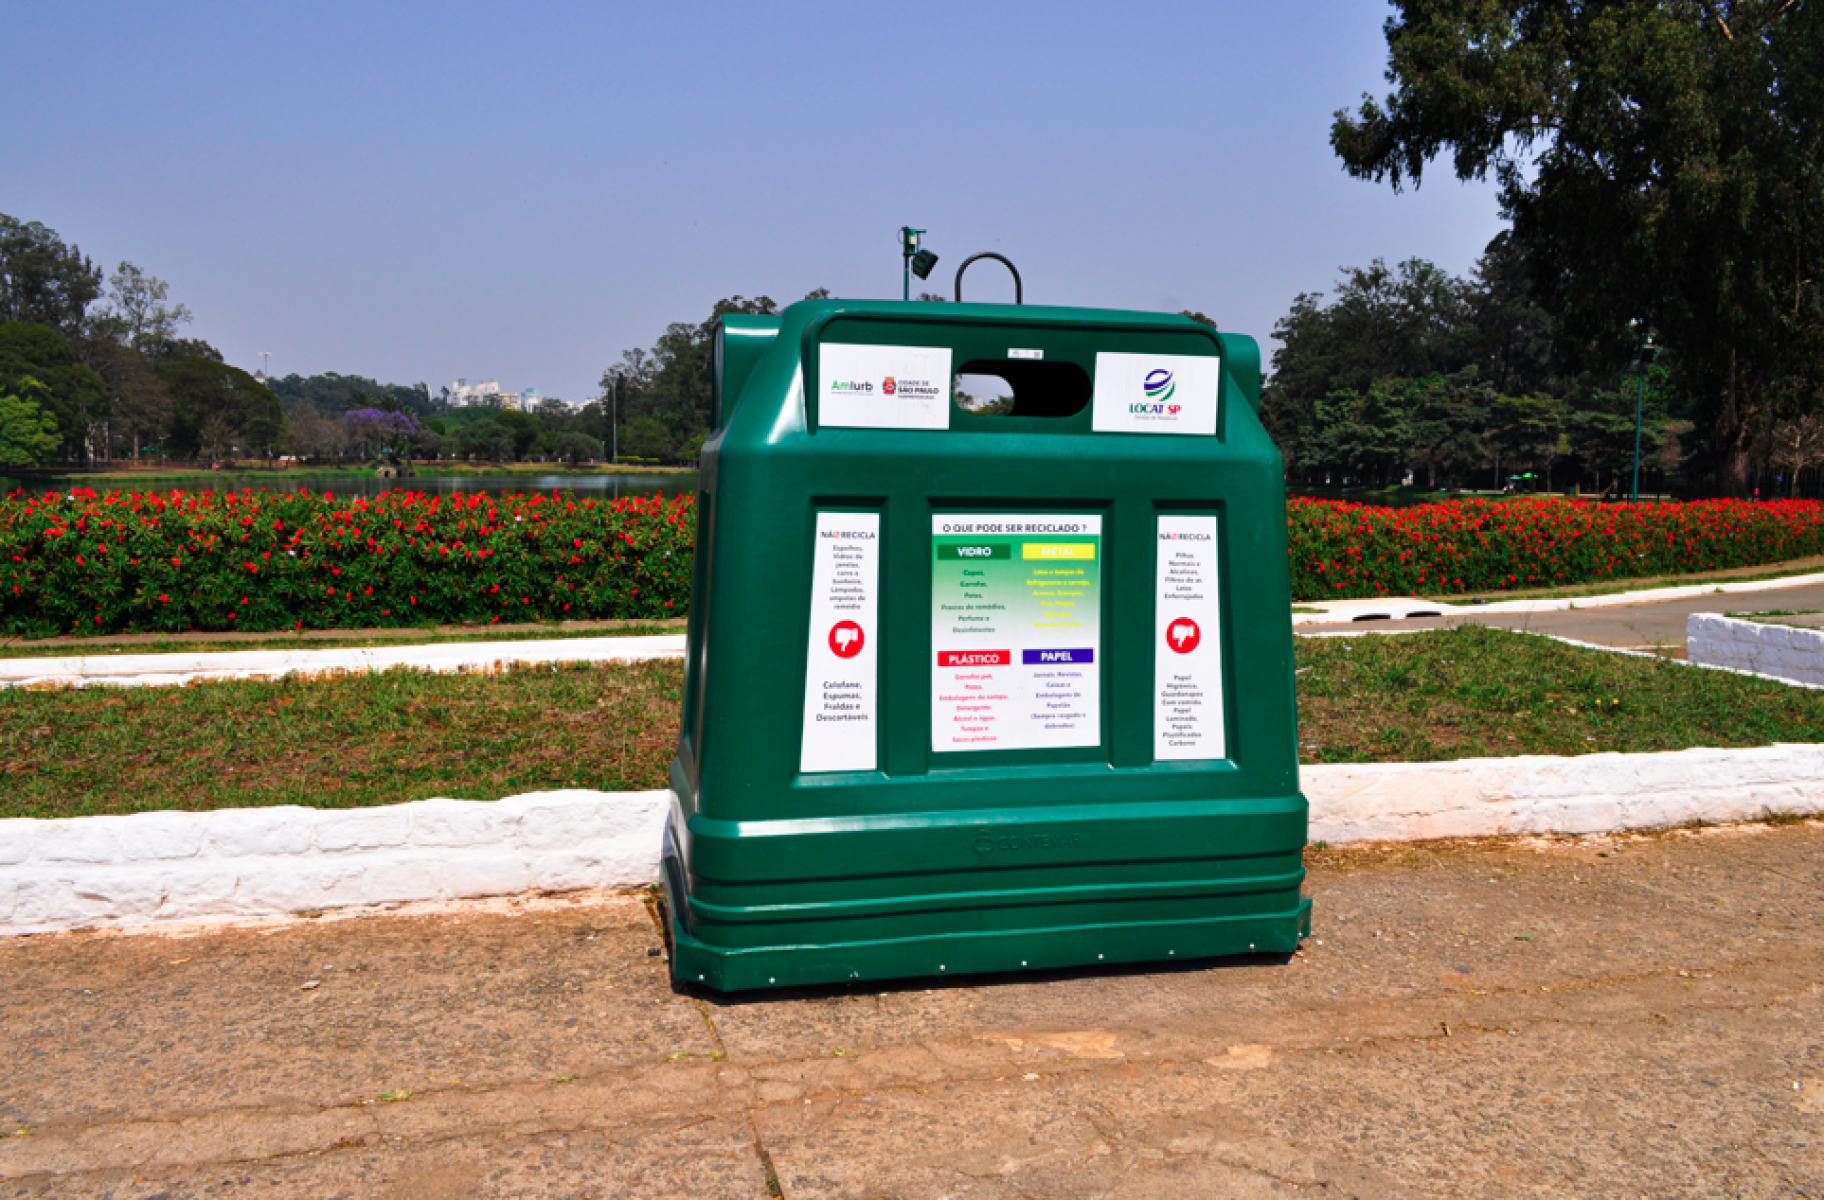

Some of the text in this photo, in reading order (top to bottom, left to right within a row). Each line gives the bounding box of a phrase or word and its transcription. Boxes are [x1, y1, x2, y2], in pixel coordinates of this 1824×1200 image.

[831, 380, 874, 391] Amlurb
[914, 386, 940, 395] PAULO
[1129, 403, 1183, 415] LOCAT SP
[943, 524, 951, 533] O
[953, 524, 974, 533] QUE
[976, 524, 1003, 533] PODE
[1005, 524, 1023, 533] SER
[1025, 524, 1080, 533] RECICLADO
[1178, 533, 1211, 541] RECICLA
[957, 547, 993, 557] VIDRO
[1042, 547, 1076, 557] METAL
[949, 653, 999, 664] PLÁSTICO
[1041, 651, 1073, 661] PAPEL
[998, 832, 1081, 852] CONTEMAR
